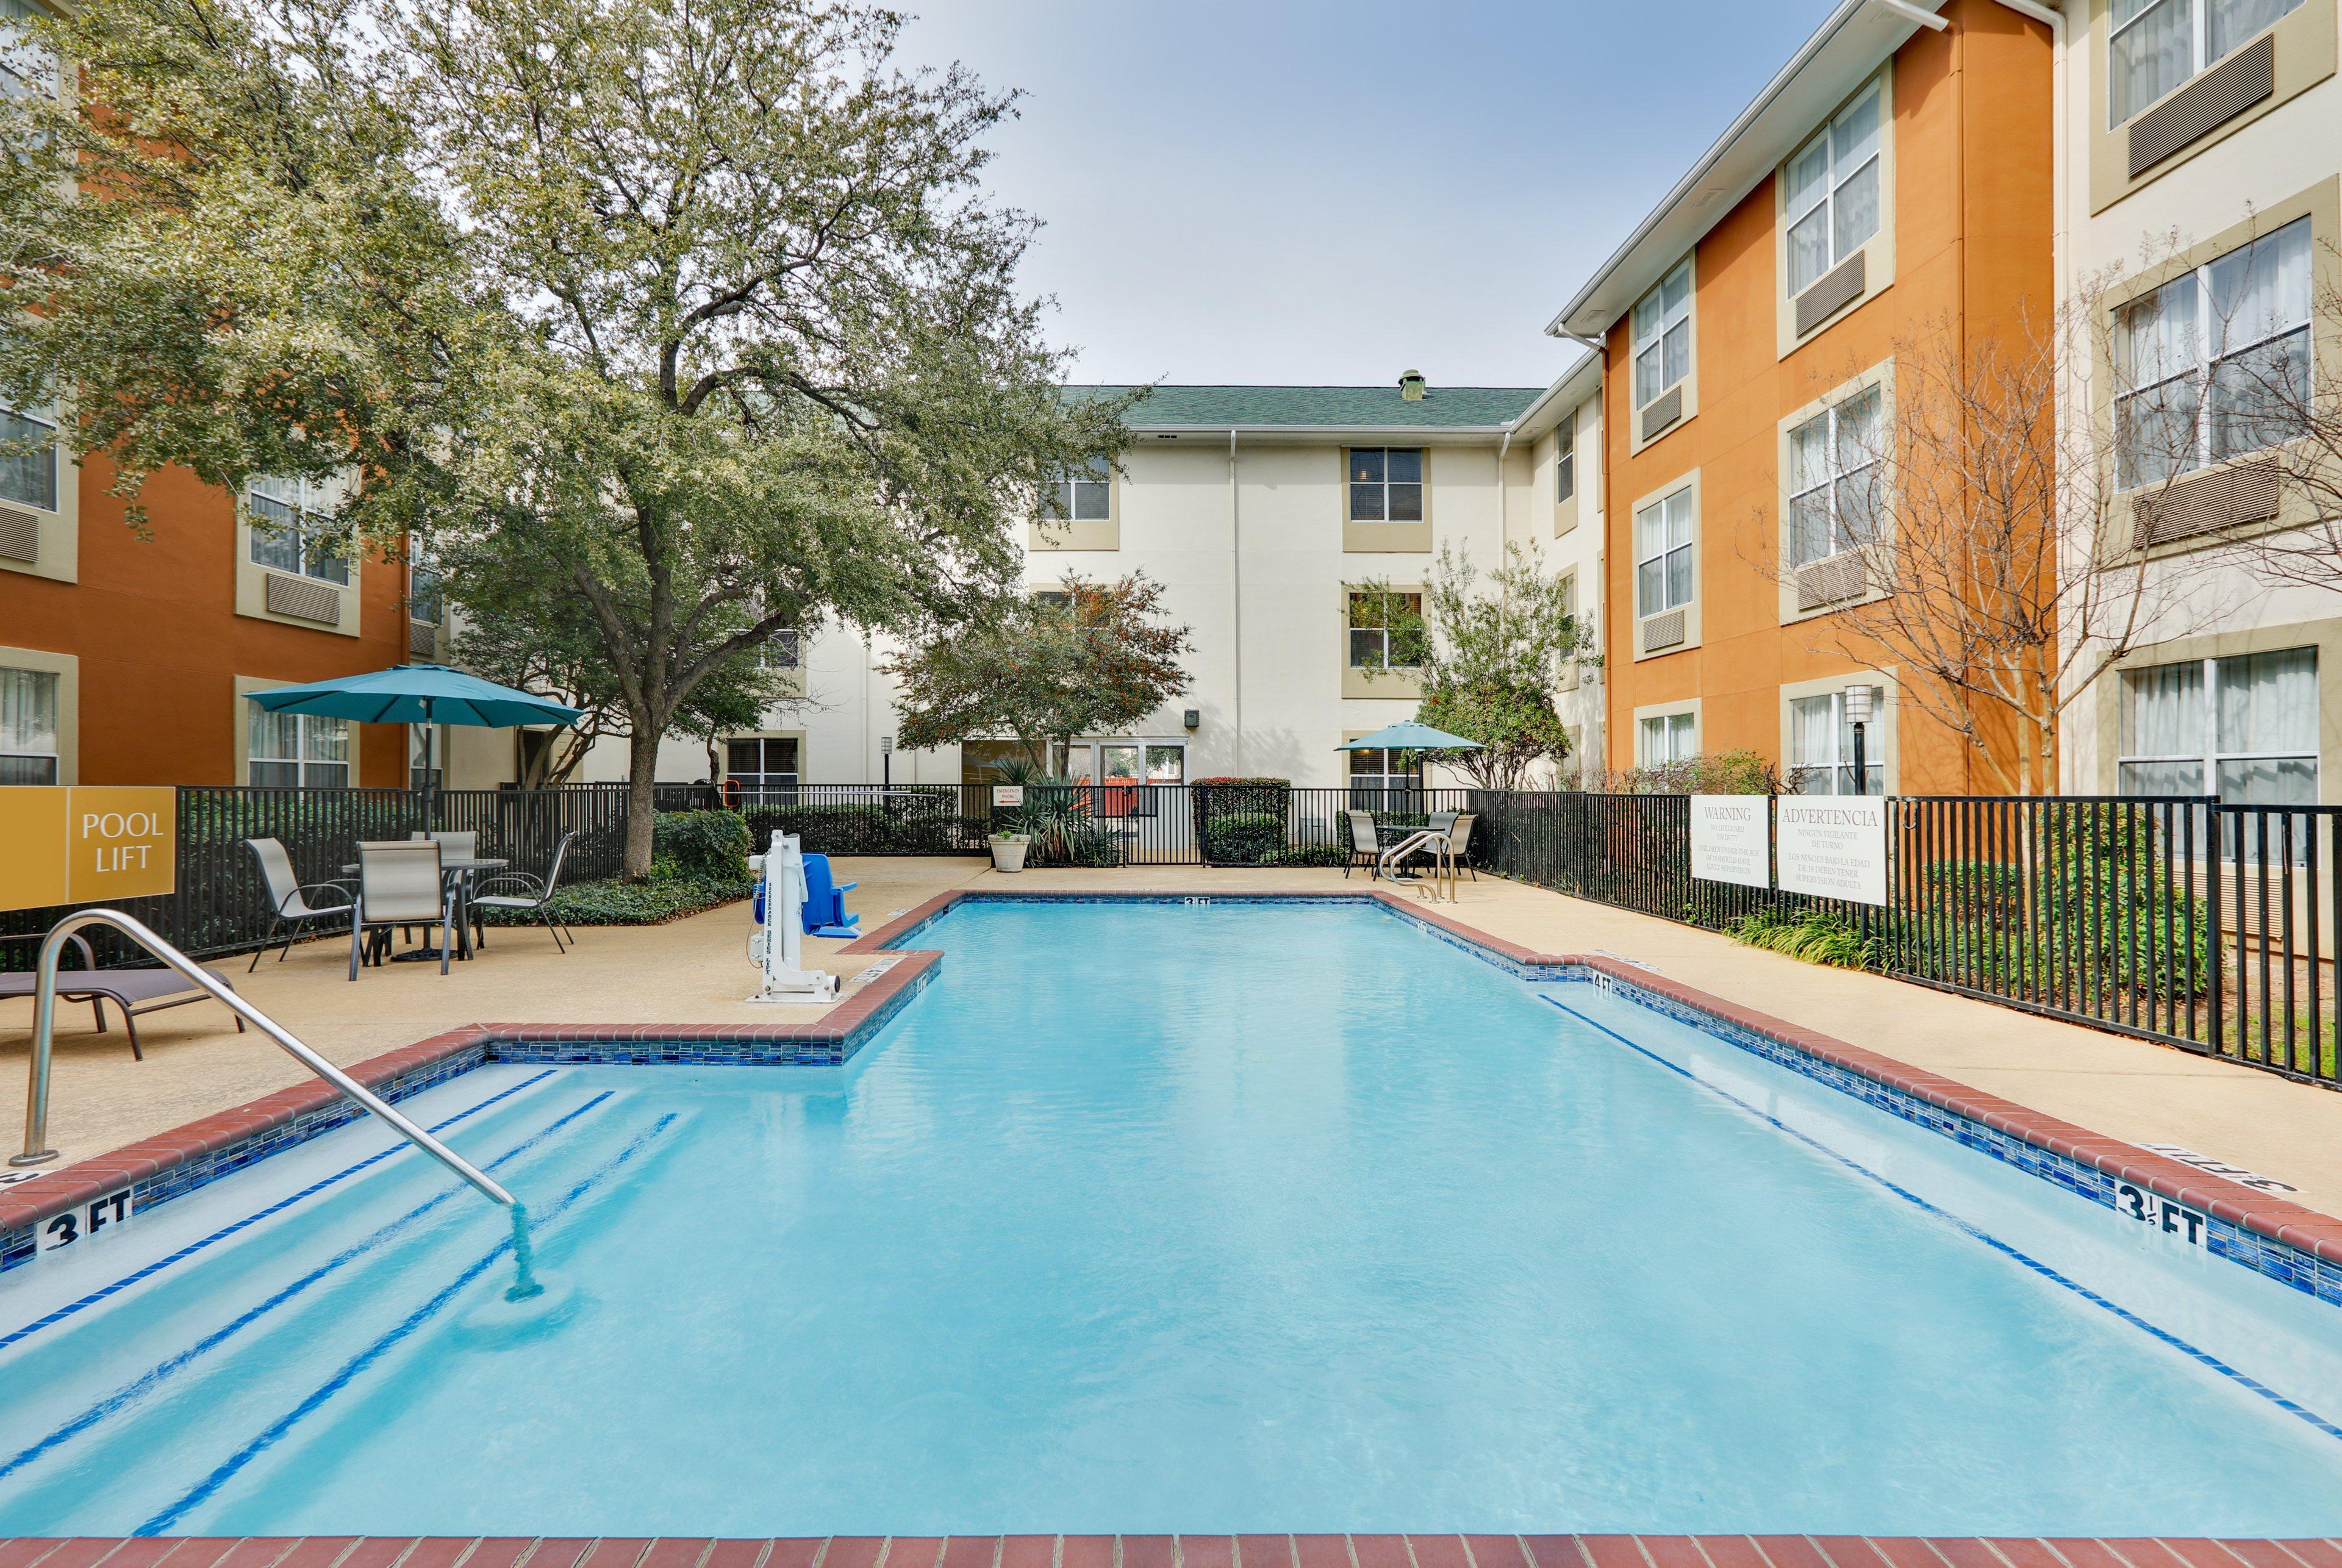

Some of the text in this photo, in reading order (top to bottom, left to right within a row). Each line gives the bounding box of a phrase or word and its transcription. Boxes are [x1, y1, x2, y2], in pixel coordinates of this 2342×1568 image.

[1704, 807, 1752, 821] WARNING
[1782, 809, 1878, 826] ADVERTENCIA
[82, 812, 164, 839] POOL
[1798, 828, 1858, 840] NINGÚN VIGILANTE
[1821, 841, 1843, 850] TURNO
[96, 845, 152, 872] LIFT
[1825, 856, 1839, 866] BAJO
[1850, 859, 1870, 868] EDAD
[1721, 865, 1752, 875] SUPERVISION
[1798, 864, 1807, 872] DE
[1815, 866, 1836, 875] DEBEN
[1837, 868, 1858, 878] TENER
[1796, 873, 1861, 889] SUPERVISION ADULTA
[45, 1214, 79, 1251] 3
